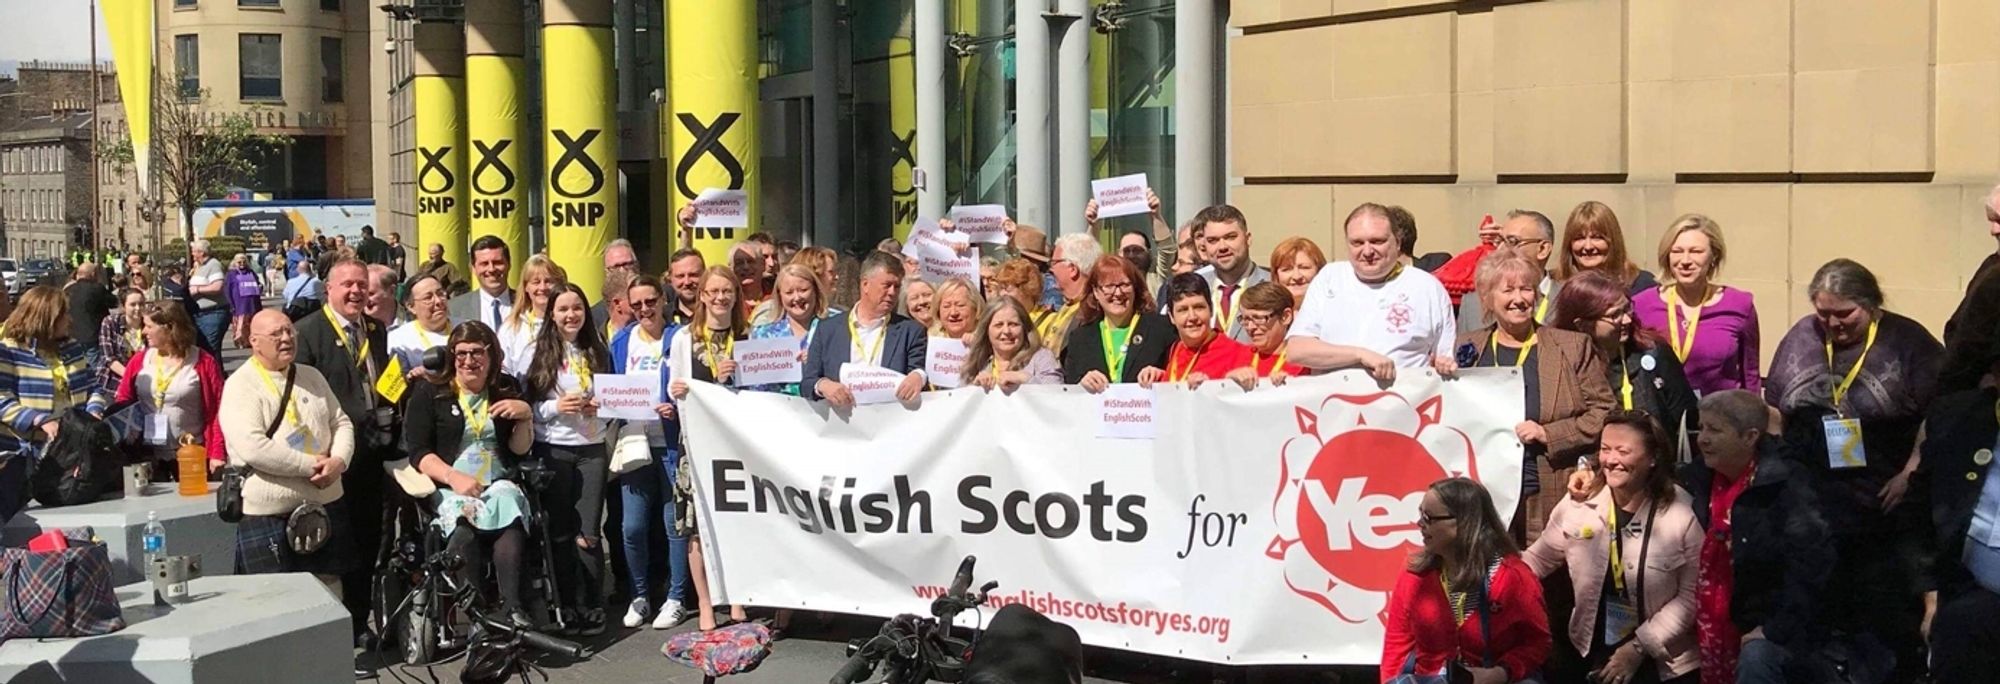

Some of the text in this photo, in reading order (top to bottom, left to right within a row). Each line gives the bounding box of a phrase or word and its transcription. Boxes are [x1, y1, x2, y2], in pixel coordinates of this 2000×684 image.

[419, 197, 454, 213] SNP
[473, 199, 515, 219] SNP
[552, 202, 604, 227] SNP
[742, 349, 794, 362] #iStandWith
[743, 362, 794, 374] EnglishScots
[602, 387, 651, 396] #iStandWith
[602, 398, 651, 409] EnglishScots
[1103, 399, 1152, 409] #iStandWith
[1103, 413, 1152, 424] EnglishScots
[712, 459, 1247, 560] English Scots for
